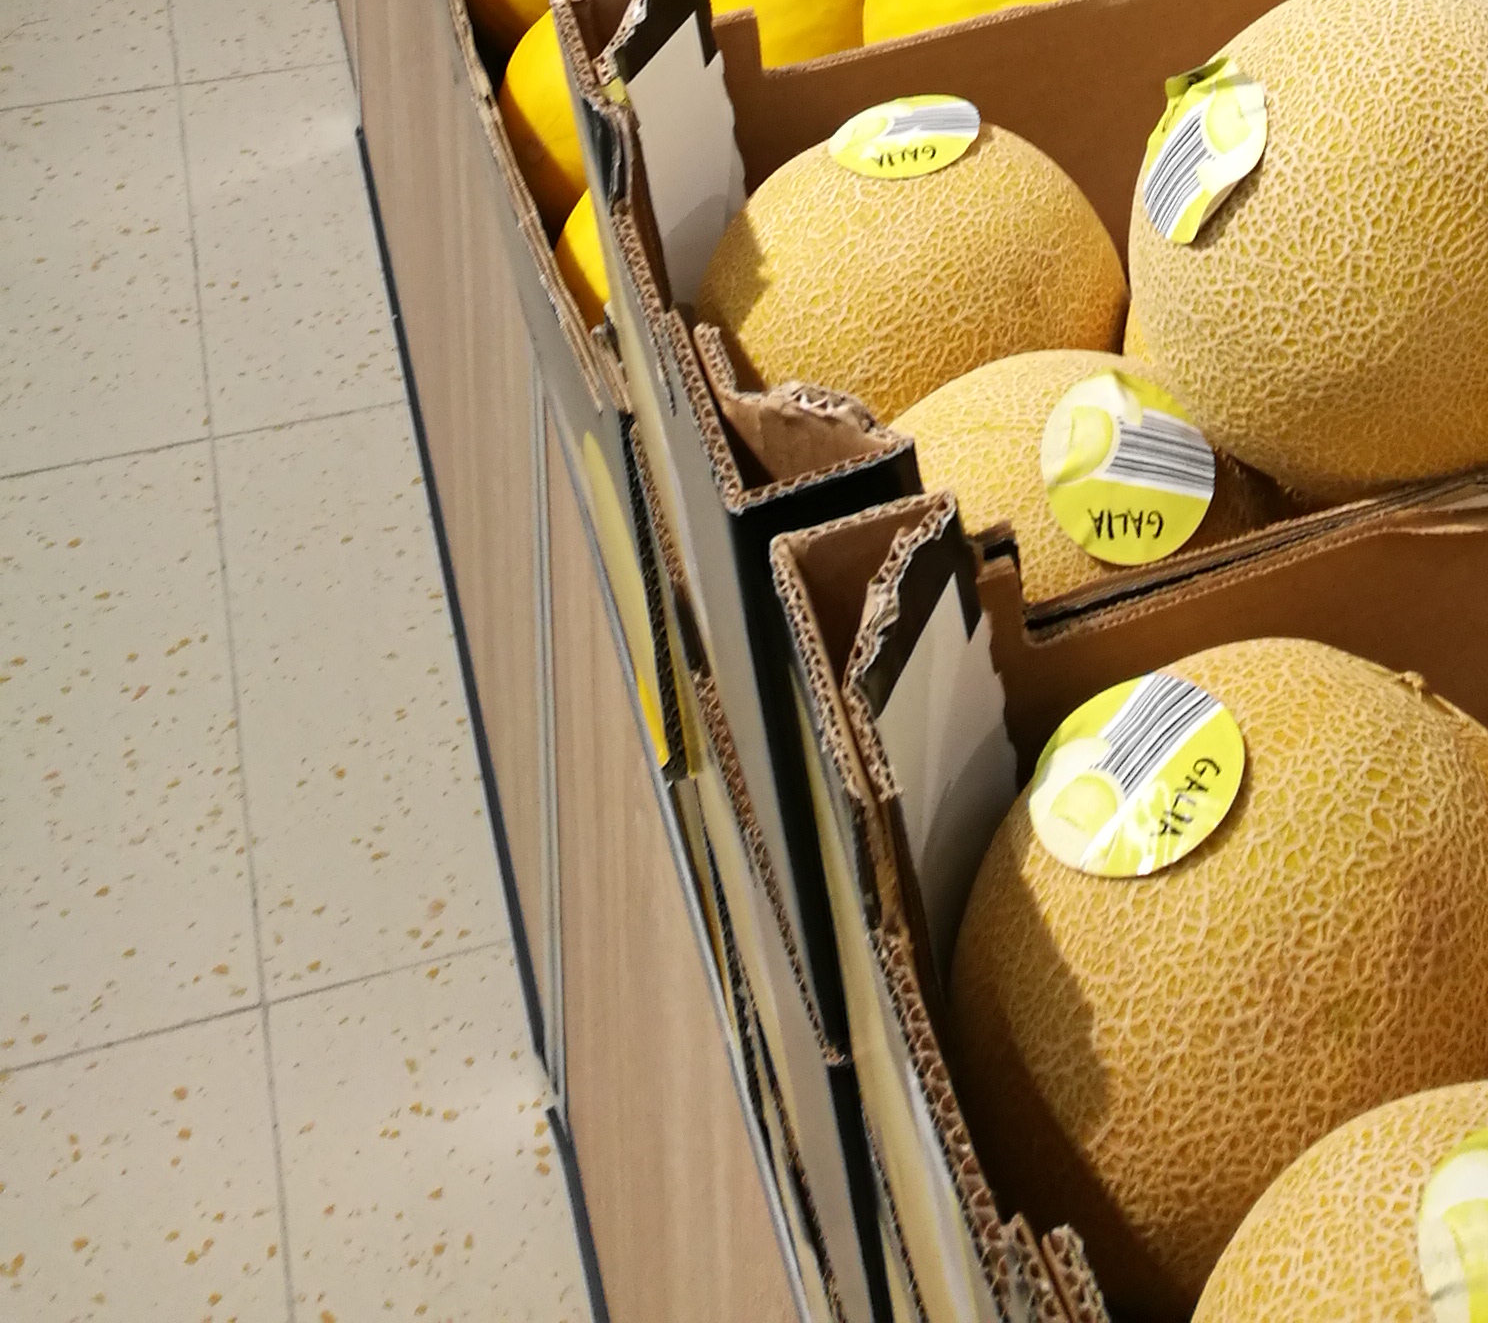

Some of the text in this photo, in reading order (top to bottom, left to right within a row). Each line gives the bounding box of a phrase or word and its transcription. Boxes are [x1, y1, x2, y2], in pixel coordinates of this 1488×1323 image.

[870, 144, 937, 170] GALIA
[1087, 508, 1165, 541] GALIA
[1149, 757, 1221, 838] GALIA
